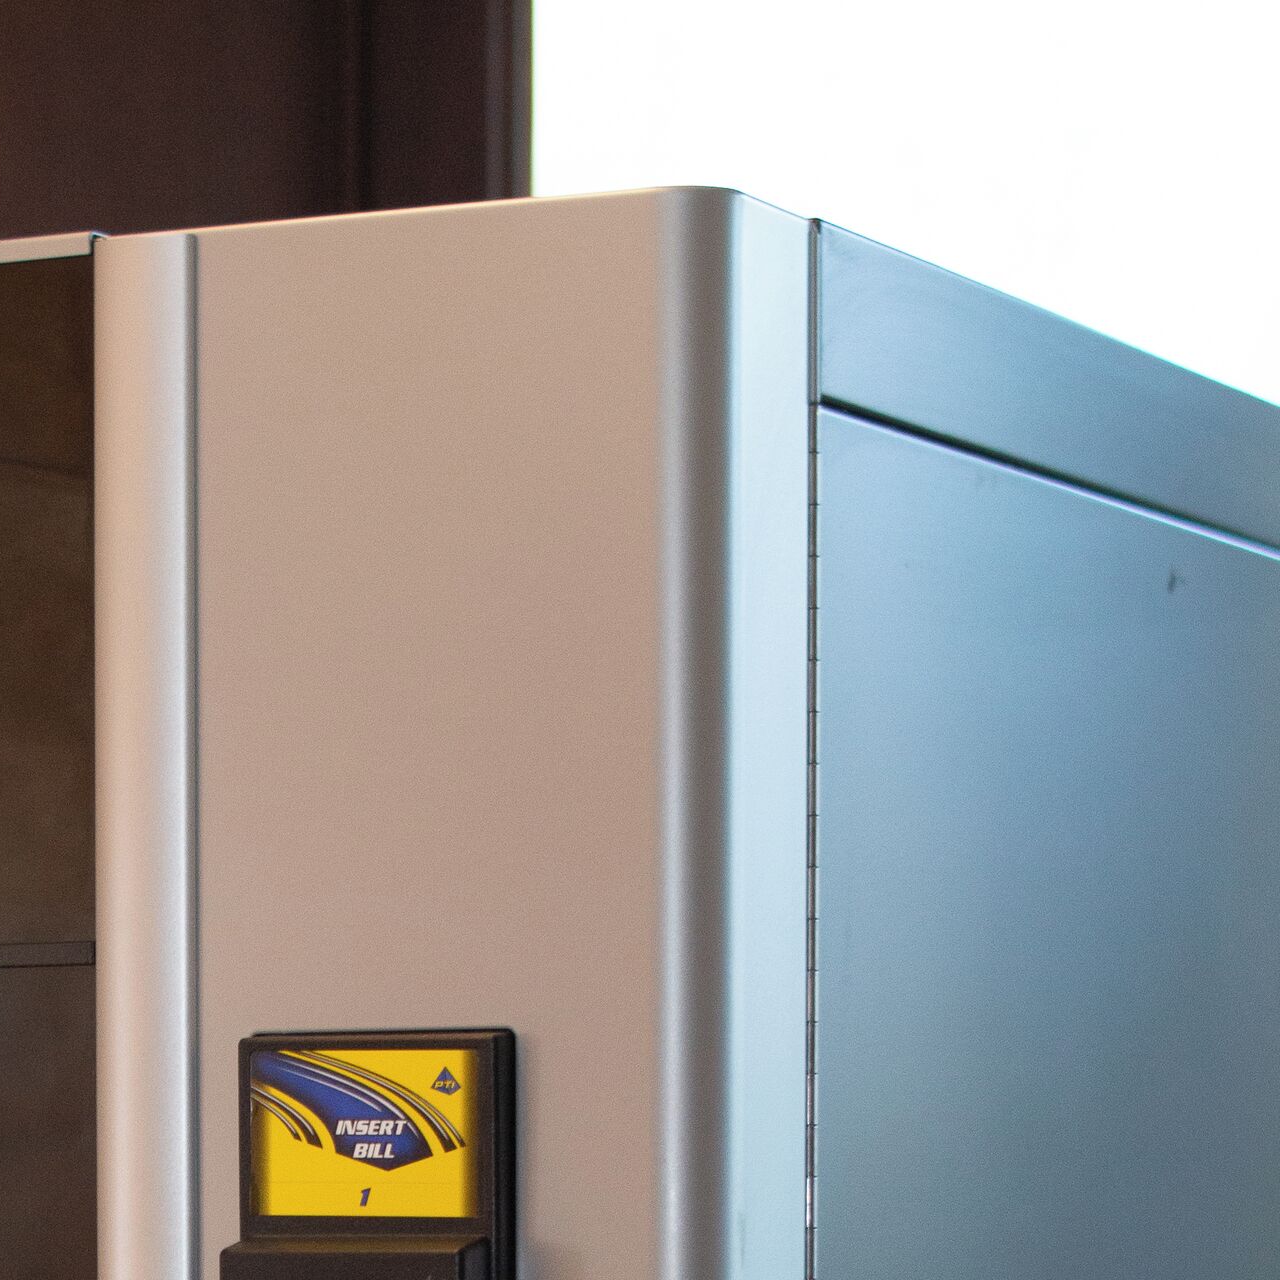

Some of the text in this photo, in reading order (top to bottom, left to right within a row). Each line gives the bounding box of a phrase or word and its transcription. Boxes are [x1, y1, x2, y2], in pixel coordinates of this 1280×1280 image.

[434, 1080, 455, 1089] PTI
[335, 1120, 408, 1137] INSERT
[353, 1143, 395, 1159] BILL
[360, 1187, 371, 1207] 1
